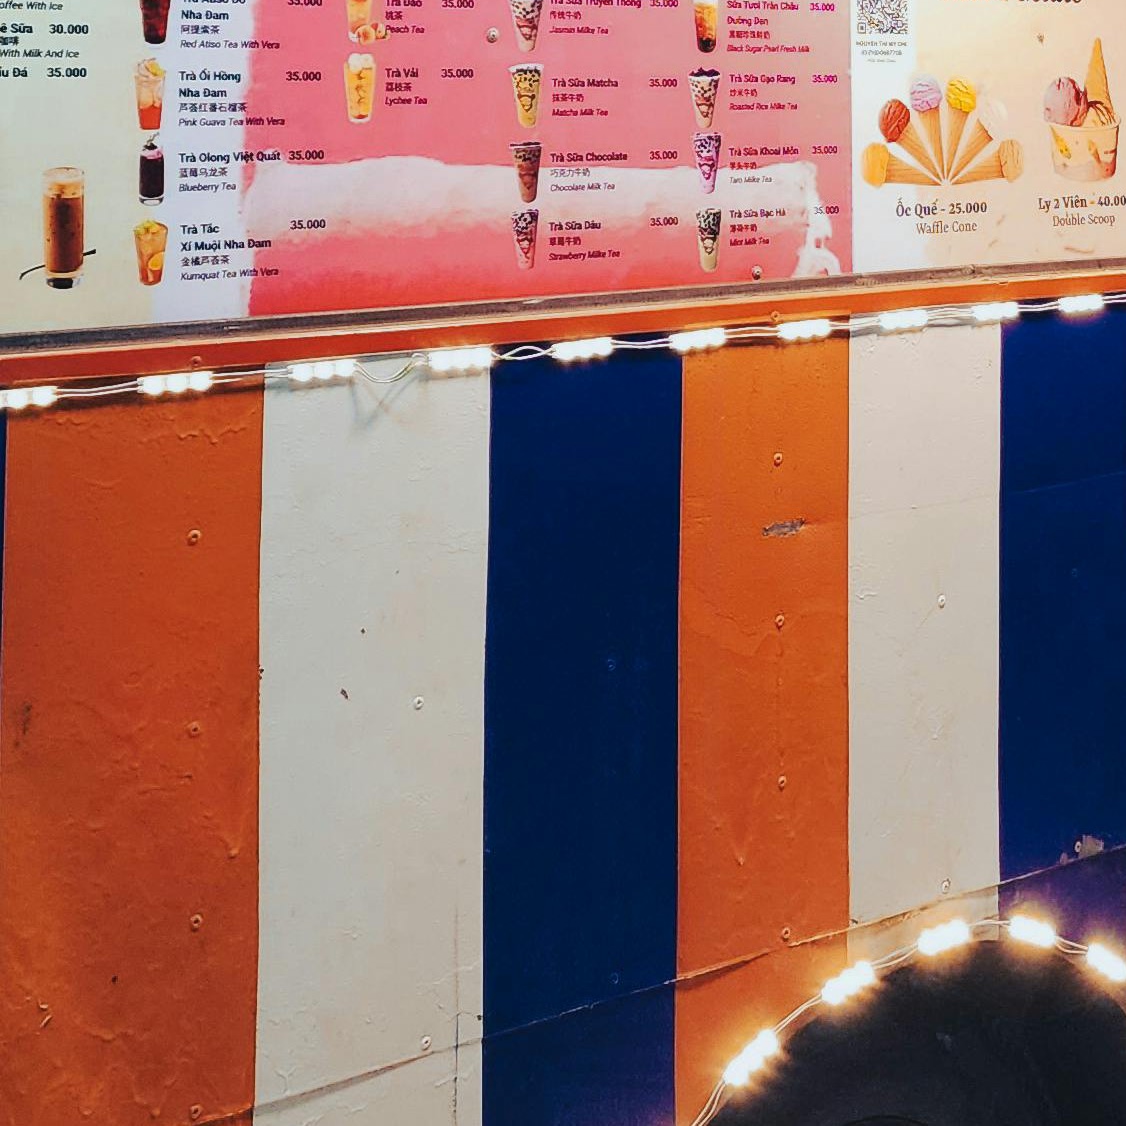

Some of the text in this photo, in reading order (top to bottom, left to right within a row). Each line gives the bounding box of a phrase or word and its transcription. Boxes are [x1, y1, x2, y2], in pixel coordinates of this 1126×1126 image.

[26, 1, 46, 10] With
[181, 10, 229, 20] Nha Đam
[49, 24, 89, 34] 30.000
[385, 25, 425, 34] Peach Tea
[180, 40, 197, 48] Red
[223, 40, 238, 49] Tea
[261, 41, 280, 50] Vera
[44, 50, 63, 58] And
[46, 67, 87, 78] 35.000
[178, 70, 196, 81] Trà
[286, 71, 322, 82] 35.000
[385, 68, 401, 78] Trà
[441, 69, 474, 78] 35.000
[552, 78, 566, 87] Trà
[587, 78, 618, 88] Matcha
[649, 79, 677, 88] 35.000
[812, 74, 838, 83] 35.000
[179, 88, 227, 98] Nha Đam
[385, 96, 427, 106] Lychee Tea
[178, 117, 197, 126] Pink
[228, 117, 243, 126] Tea
[812, 146, 838, 154] 35.000
[178, 152, 196, 163] Trà
[199, 153, 230, 164] Olong
[288, 150, 324, 161] 35.000
[550, 153, 564, 163] Trà
[585, 152, 628, 162] Chocolate
[650, 151, 678, 160] 35.000
[179, 182, 236, 192] Blueberry Tea
[550, 184, 585, 192] Chocolate
[949, 202, 987, 215] 25.000
[1038, 198, 1051, 212] Ly
[1053, 198, 1060, 209] 2
[1062, 196, 1088, 208] Viên
[814, 206, 839, 214] 35.000
[549, 221, 563, 231] Trà
[650, 217, 678, 227] 35.000
[1053, 213, 1115, 227] Double Scoop
[180, 224, 198, 235] Trà
[290, 219, 326, 230] 35.000
[915, 221, 978, 235] Waffle Cone
[223, 239, 244, 249] Nha
[247, 238, 272, 248] Đam
[180, 272, 219, 281] Kumquat
[222, 270, 237, 278] Tea
